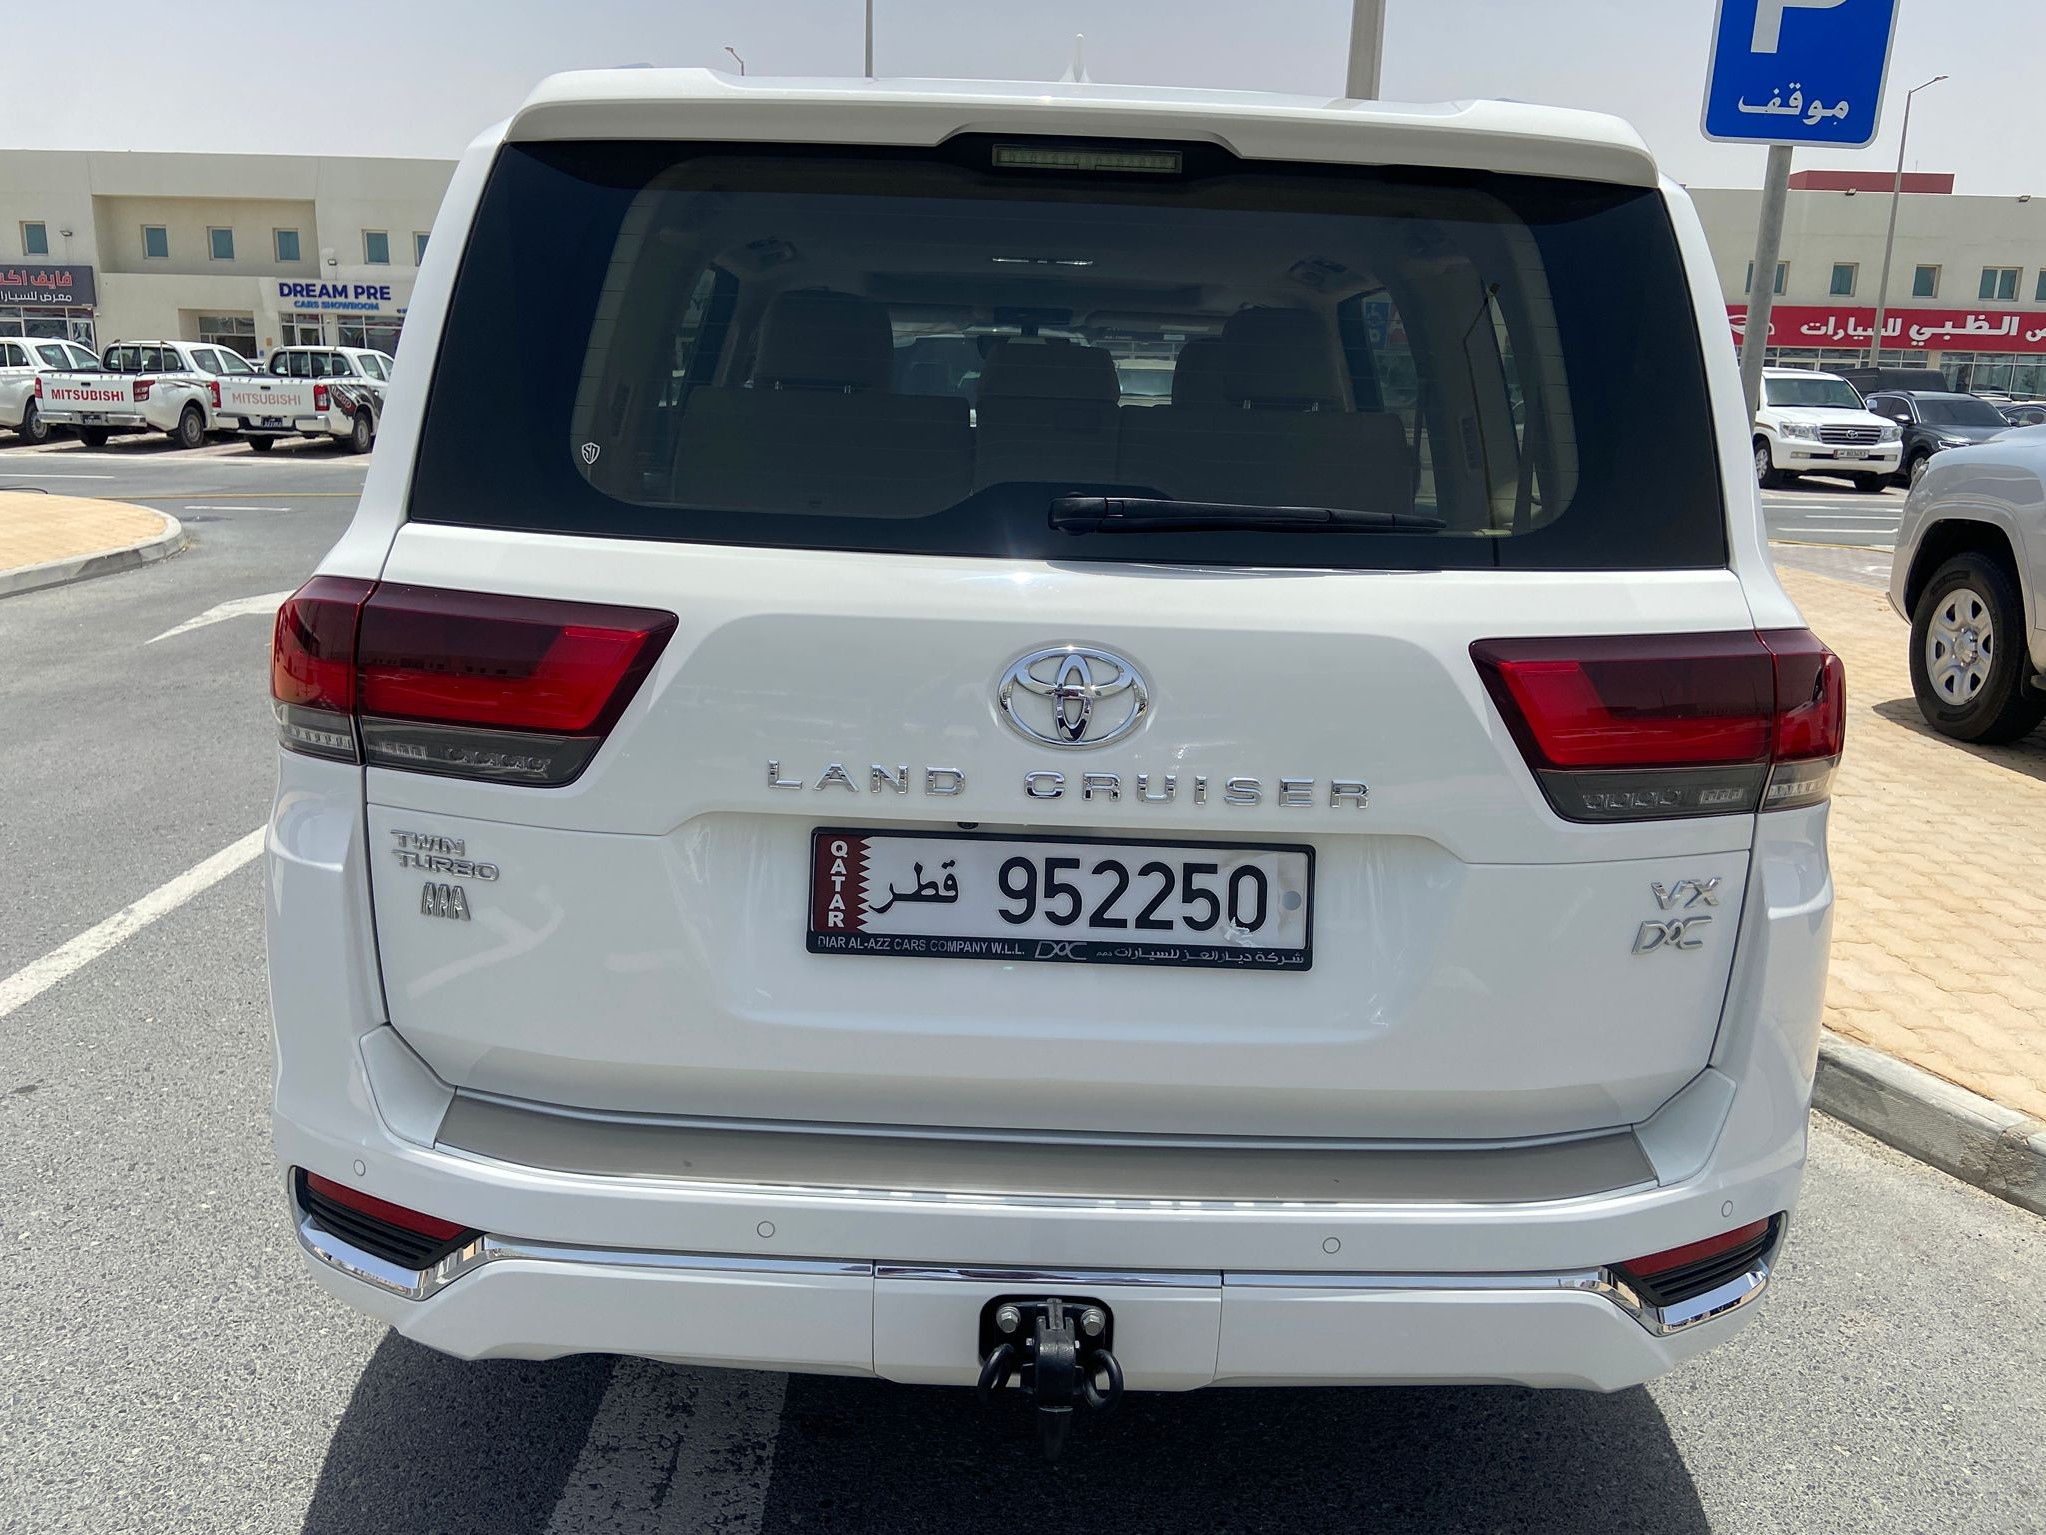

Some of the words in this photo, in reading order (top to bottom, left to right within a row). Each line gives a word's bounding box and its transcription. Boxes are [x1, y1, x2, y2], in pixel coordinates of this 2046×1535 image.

[1738, 82, 1849, 125] موقف
[30, 270, 73, 289] فايف
[0, 290, 38, 303] للسيارا
[39, 291, 73, 303] معرض
[278, 282, 349, 299] DREAM
[353, 284, 392, 301] PRE
[293, 300, 320, 309] CARS
[320, 301, 380, 311] SHOWROOM
[1799, 315, 1903, 340] للسيارات
[1908, 314, 2020, 346] الظبي
[51, 389, 125, 402] MITSUBISHI
[231, 392, 302, 407] MITSUBISHI
[766, 758, 967, 797] LAND
[1023, 769, 1371, 810] CRUISER
[389, 828, 466, 857] TWIN
[390, 848, 500, 881] TURBO
[827, 840, 848, 928] QATAR
[868, 859, 959, 914] قطر
[997, 855, 1268, 934] 952250
[1650, 876, 1722, 911] VX
[817, 934, 846, 949] DIAR
[848, 936, 891, 950] AL-AZZ
[893, 938, 927, 951] CARS
[929, 939, 989, 953] COMPANY
[990, 941, 1026, 956] W.L.L.
[1114, 947, 1180, 961] للسيارات
[1255, 951, 1304, 966] شركة
